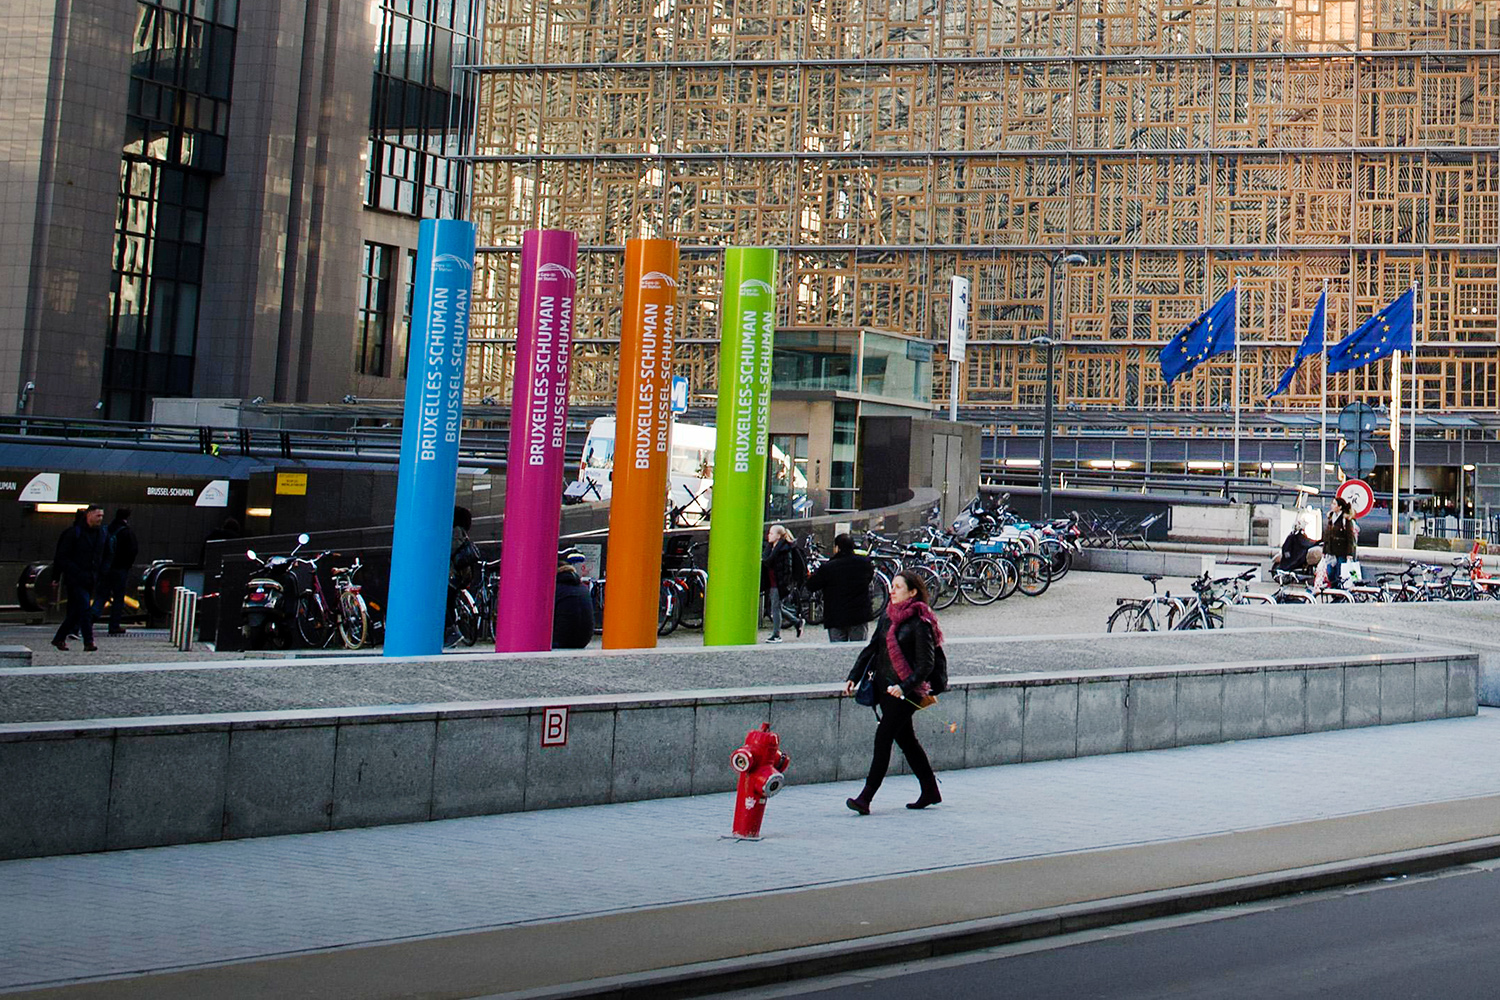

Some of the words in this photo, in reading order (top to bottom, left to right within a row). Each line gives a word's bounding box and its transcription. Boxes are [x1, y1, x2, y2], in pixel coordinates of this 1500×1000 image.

[421, 287, 449, 461] BRUXELLES-SCHUMAN
[445, 288, 468, 443] BRUSSEL-SCHUMAN
[529, 296, 555, 466] BRUXELLES-SCHUMAN
[552, 297, 572, 448] BRUSSEL-SCHUMAN
[635, 303, 659, 469] BRUXELLES-SCHUMAN
[656, 304, 674, 452] BRUSSEL-SCHUMAN
[735, 310, 757, 473] BRUXELLES-SCHUMAN
[755, 311, 773, 456] BRUSSEL-SCHUMAN
[147, 486, 195, 497] BRUSSEL-SCHUMAN
[547, 713, 563, 739] B
